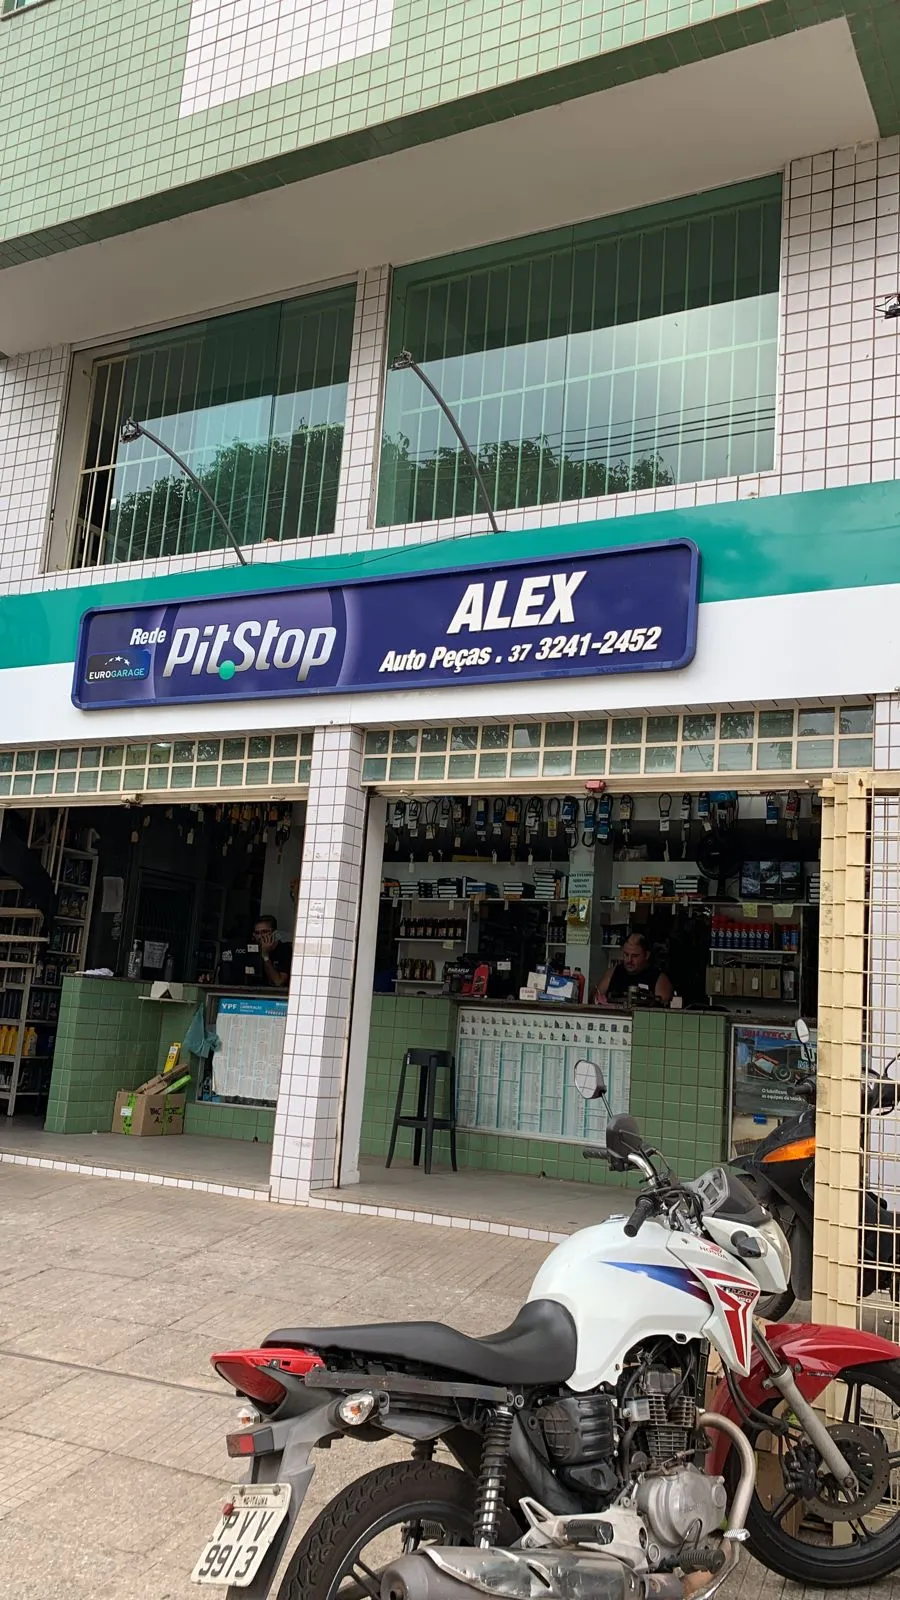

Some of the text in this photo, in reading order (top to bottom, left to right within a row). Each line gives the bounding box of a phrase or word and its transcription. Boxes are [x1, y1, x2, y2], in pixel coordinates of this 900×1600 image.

[446, 570, 588, 634] ALEX
[129, 627, 167, 646] Rede
[378, 650, 427, 673] Auto
[429, 646, 492, 673] Peças
[508, 643, 532, 662] 37
[535, 626, 662, 660] 3241-2452
[89, 667, 145, 680] EUROGARAGE
[217, 1510, 275, 1541] PVV
[198, 1544, 259, 1578] 9913
